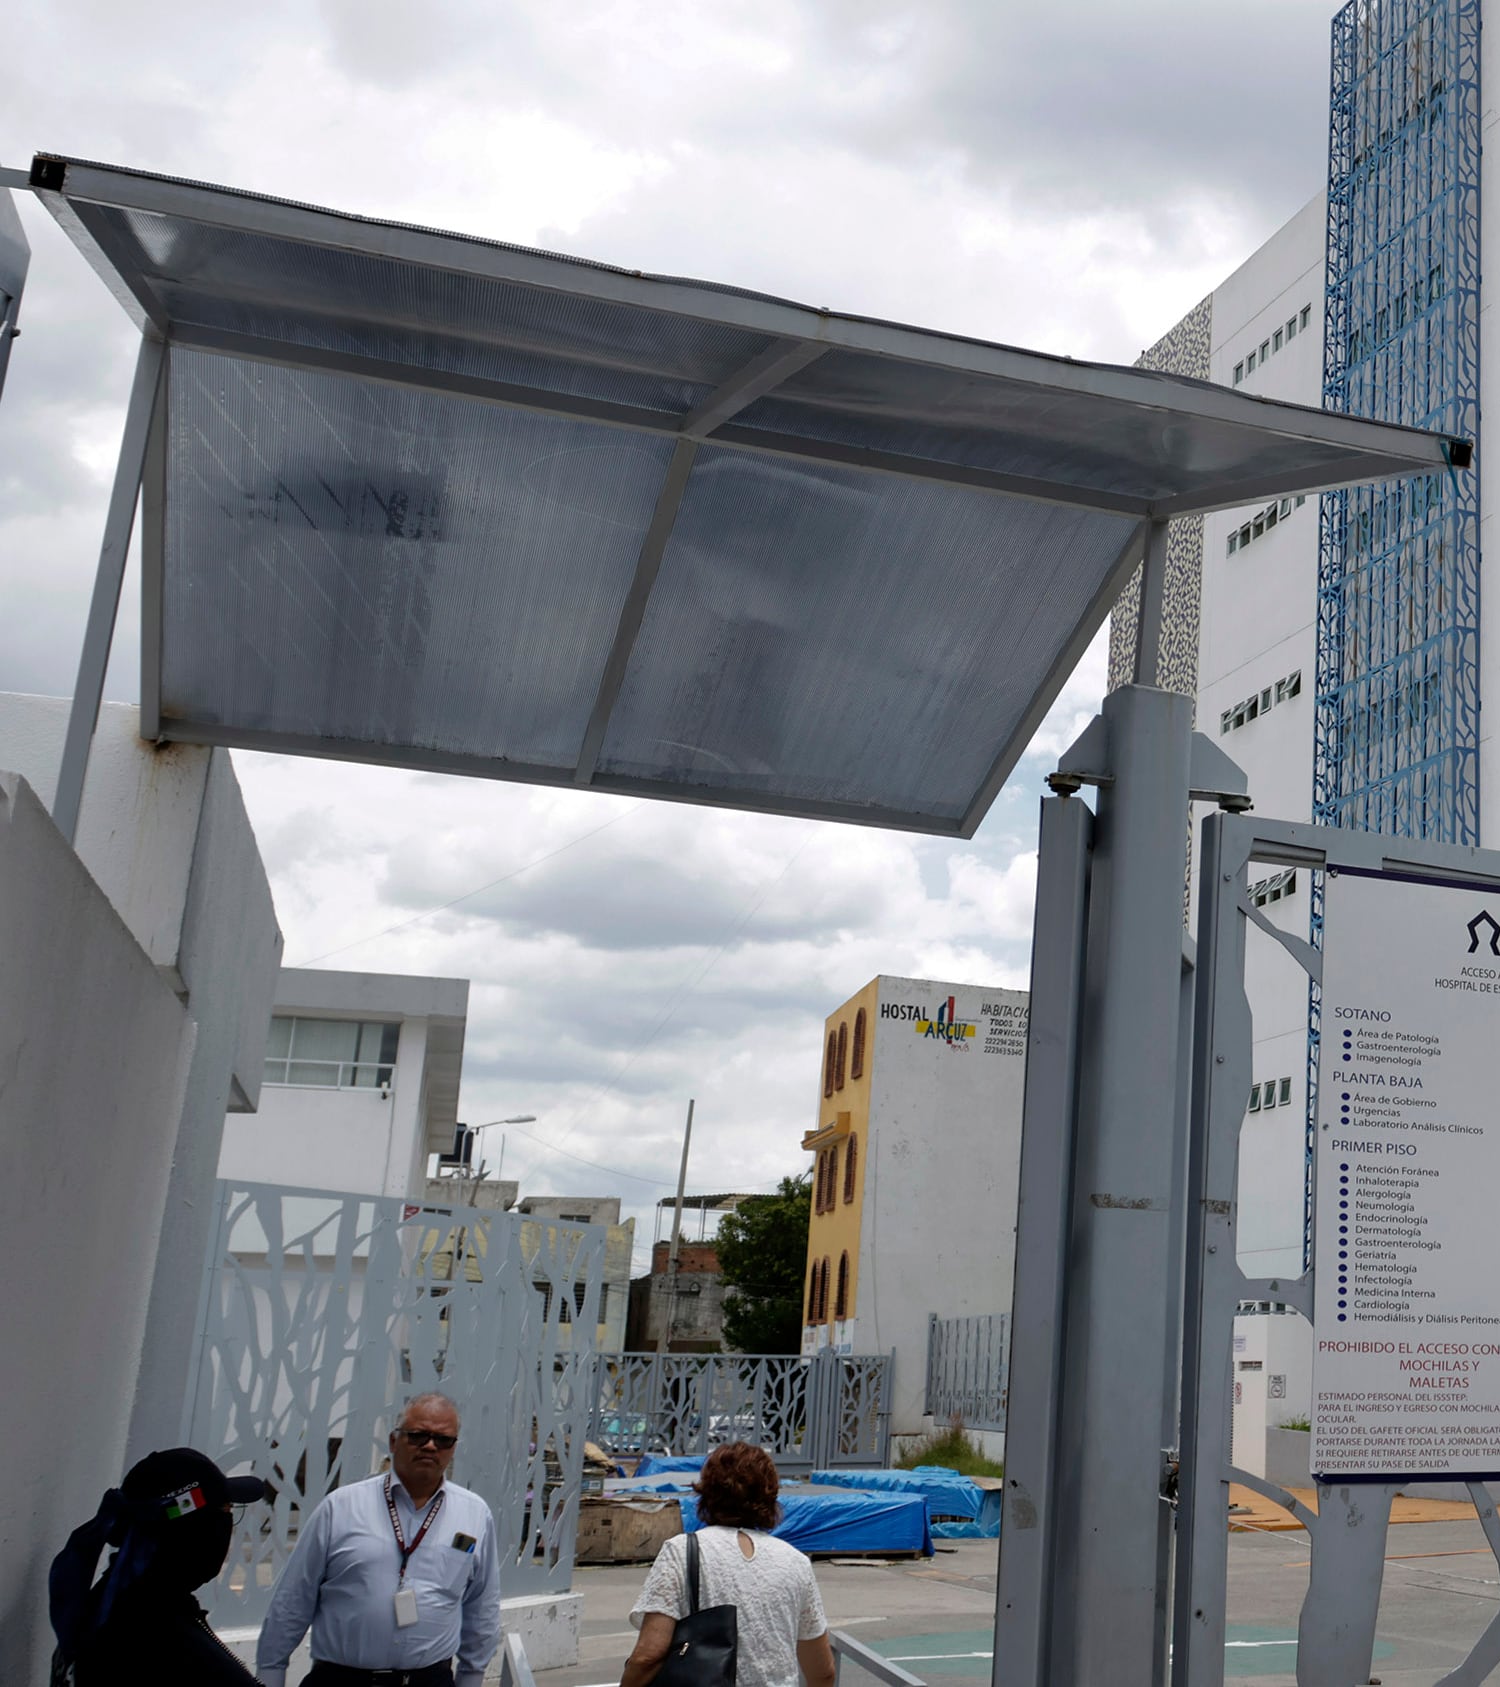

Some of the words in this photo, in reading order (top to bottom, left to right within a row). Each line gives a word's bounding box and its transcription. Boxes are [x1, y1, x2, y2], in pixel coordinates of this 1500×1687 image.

[1460, 966, 1496, 979] ACCESO
[1434, 978, 1477, 991] HOSPITAL
[1479, 982, 1491, 993] DE
[881, 1003, 929, 1021] HOSTAL
[1334, 1006, 1391, 1022] SOTANO
[924, 1023, 968, 1042] ARCUZ
[1357, 1028, 1379, 1038] Área
[1381, 1031, 1393, 1040] de
[1395, 1032, 1439, 1045] Patología
[1356, 1040, 1441, 1057] Gastroenterología
[1356, 1052, 1421, 1067] Imagenología
[1333, 1070, 1385, 1085] PLANTA
[1389, 1075, 1423, 1088] BAJA
[1353, 1093, 1376, 1104] Área
[1378, 1095, 1390, 1105] de
[1392, 1098, 1437, 1108] Gobierno
[1353, 1105, 1401, 1117] Urgencias
[1353, 1117, 1409, 1129] Laboratorio
[1410, 1121, 1446, 1132] Análisis
[1447, 1124, 1483, 1135] Clínicos
[1331, 1139, 1382, 1153] PRIMER
[1386, 1143, 1417, 1156] PISO
[1355, 1164, 1399, 1174] Atención
[1401, 1166, 1439, 1177] Foránea
[1355, 1176, 1419, 1189] Inhaloterapia
[1355, 1188, 1411, 1201] Alergología
[1355, 1201, 1414, 1212] Neumología
[1355, 1213, 1428, 1226] Endocrinología
[1355, 1225, 1421, 1238] Dermatología
[1354, 1237, 1441, 1250] Gastroenterología
[1354, 1249, 1396, 1260] Geriatría
[1354, 1262, 1417, 1274] Hematología
[1354, 1275, 1412, 1286] Infectología
[1354, 1287, 1399, 1297] Medicina
[1401, 1289, 1435, 1298] Interna
[1354, 1299, 1410, 1311] Cardiología
[1354, 1312, 1416, 1322] Hemodiálisis
[1417, 1316, 1423, 1324] y
[1425, 1314, 1458, 1323] Diálisis
[1319, 1340, 1395, 1353] PROHIBIDO
[1398, 1342, 1413, 1354] EL
[1416, 1342, 1469, 1354] ACCESO
[1471, 1343, 1500, 1355] CON
[1399, 1359, 1469, 1372] MOCHILAS
[1471, 1361, 1480, 1371] Y
[1409, 1376, 1469, 1388] MALETAS
[1318, 1392, 1365, 1401] ESTIMADO
[1367, 1392, 1413, 1401] PERSONAL
[1415, 1393, 1432, 1401] DEL
[1317, 1404, 1341, 1412] PARA
[1343, 1404, 1353, 1412] EL
[1355, 1404, 1395, 1412] INGRESO
[1395, 1404, 1402, 1412] Y
[1403, 1404, 1437, 1412] EGRESO
[1438, 1404, 1458, 1412] CON
[1316, 1426, 1327, 1435] EL
[1329, 1426, 1349, 1435] USO
[1350, 1426, 1368, 1434] DEL
[1369, 1426, 1403, 1435] GAFETE
[1404, 1426, 1438, 1434] OFICIAL
[1316, 1437, 1361, 1446] PORTARSE
[1363, 1437, 1406, 1446] DURANTE
[1408, 1437, 1432, 1446] TODA
[1434, 1437, 1445, 1446] LA
[1447, 1437, 1488, 1445] JORNADA
